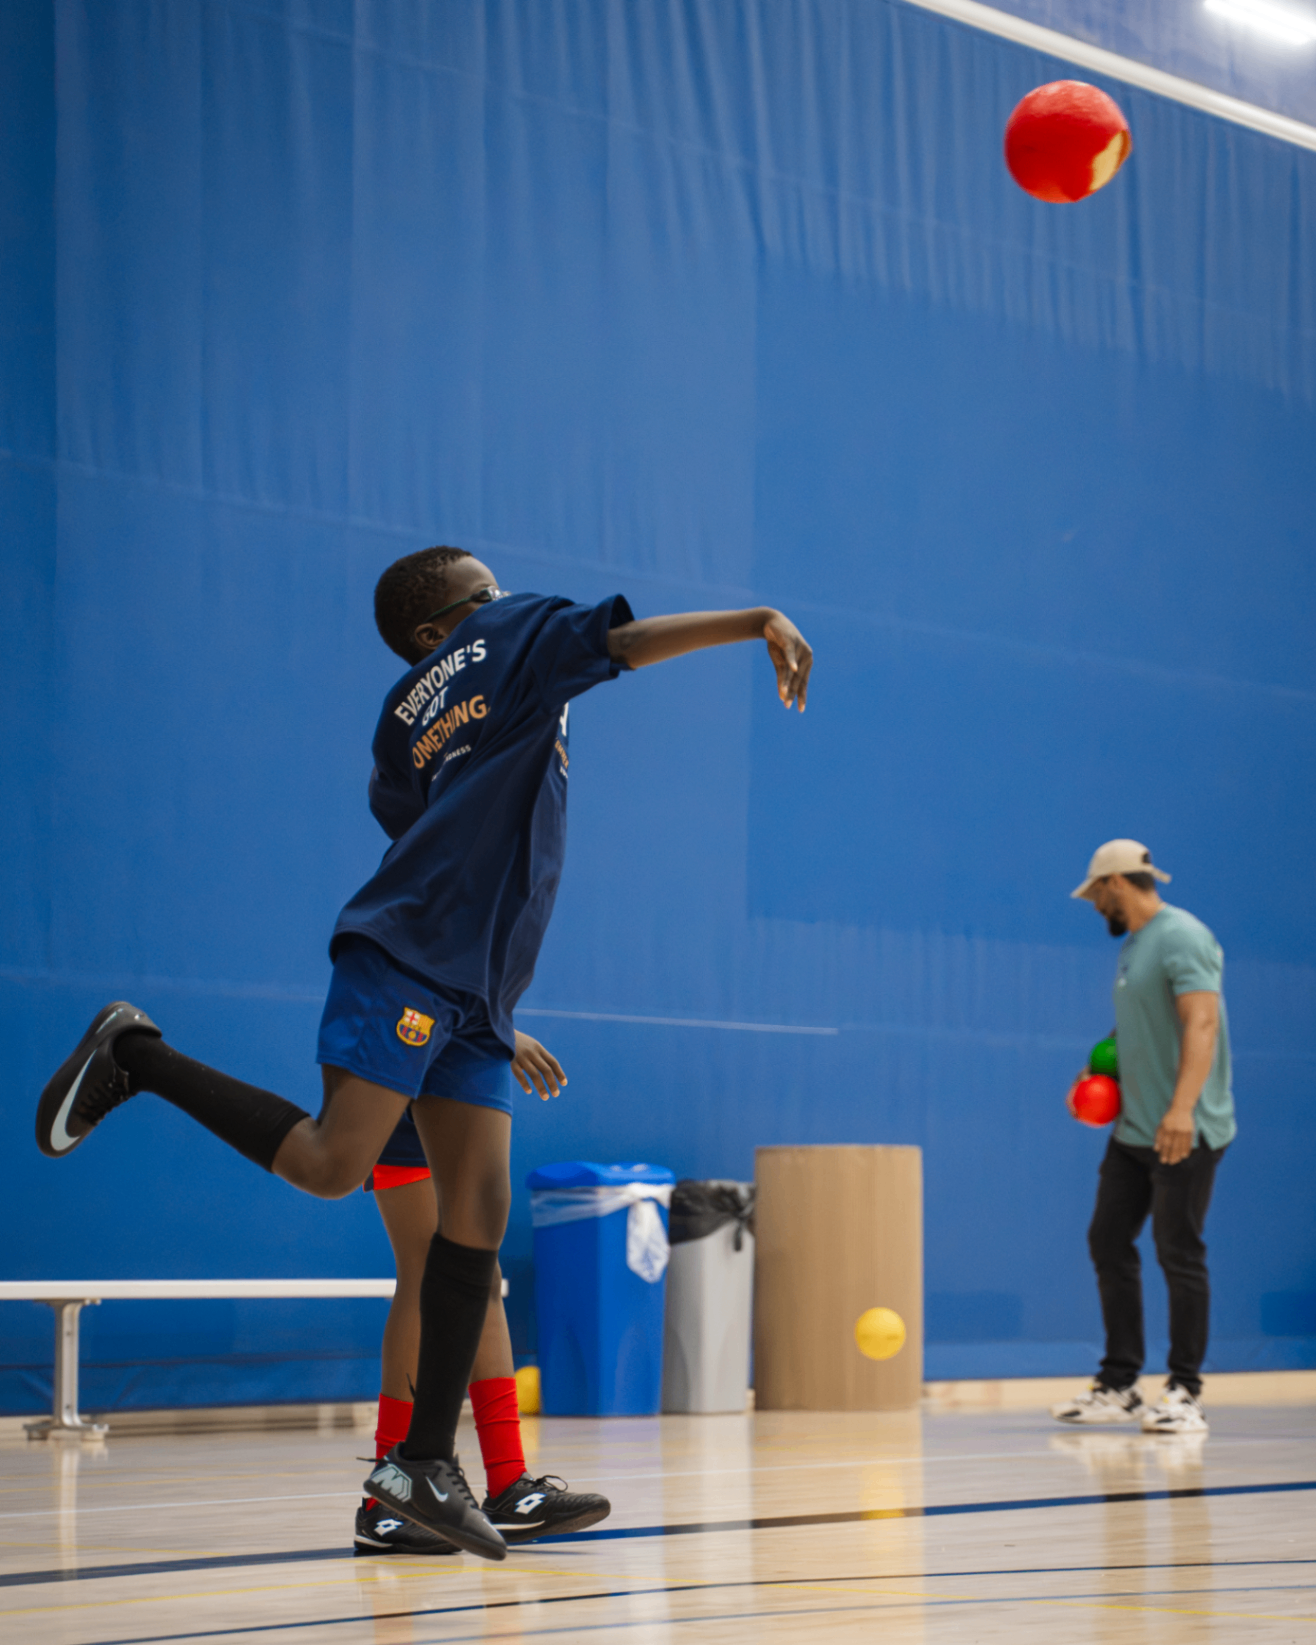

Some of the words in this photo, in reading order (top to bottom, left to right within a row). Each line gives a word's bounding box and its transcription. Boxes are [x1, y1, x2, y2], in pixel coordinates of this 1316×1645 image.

[394, 639, 487, 726] EVERYONE'S
[421, 686, 449, 727] GOT
[412, 694, 488, 769] OMETHING
